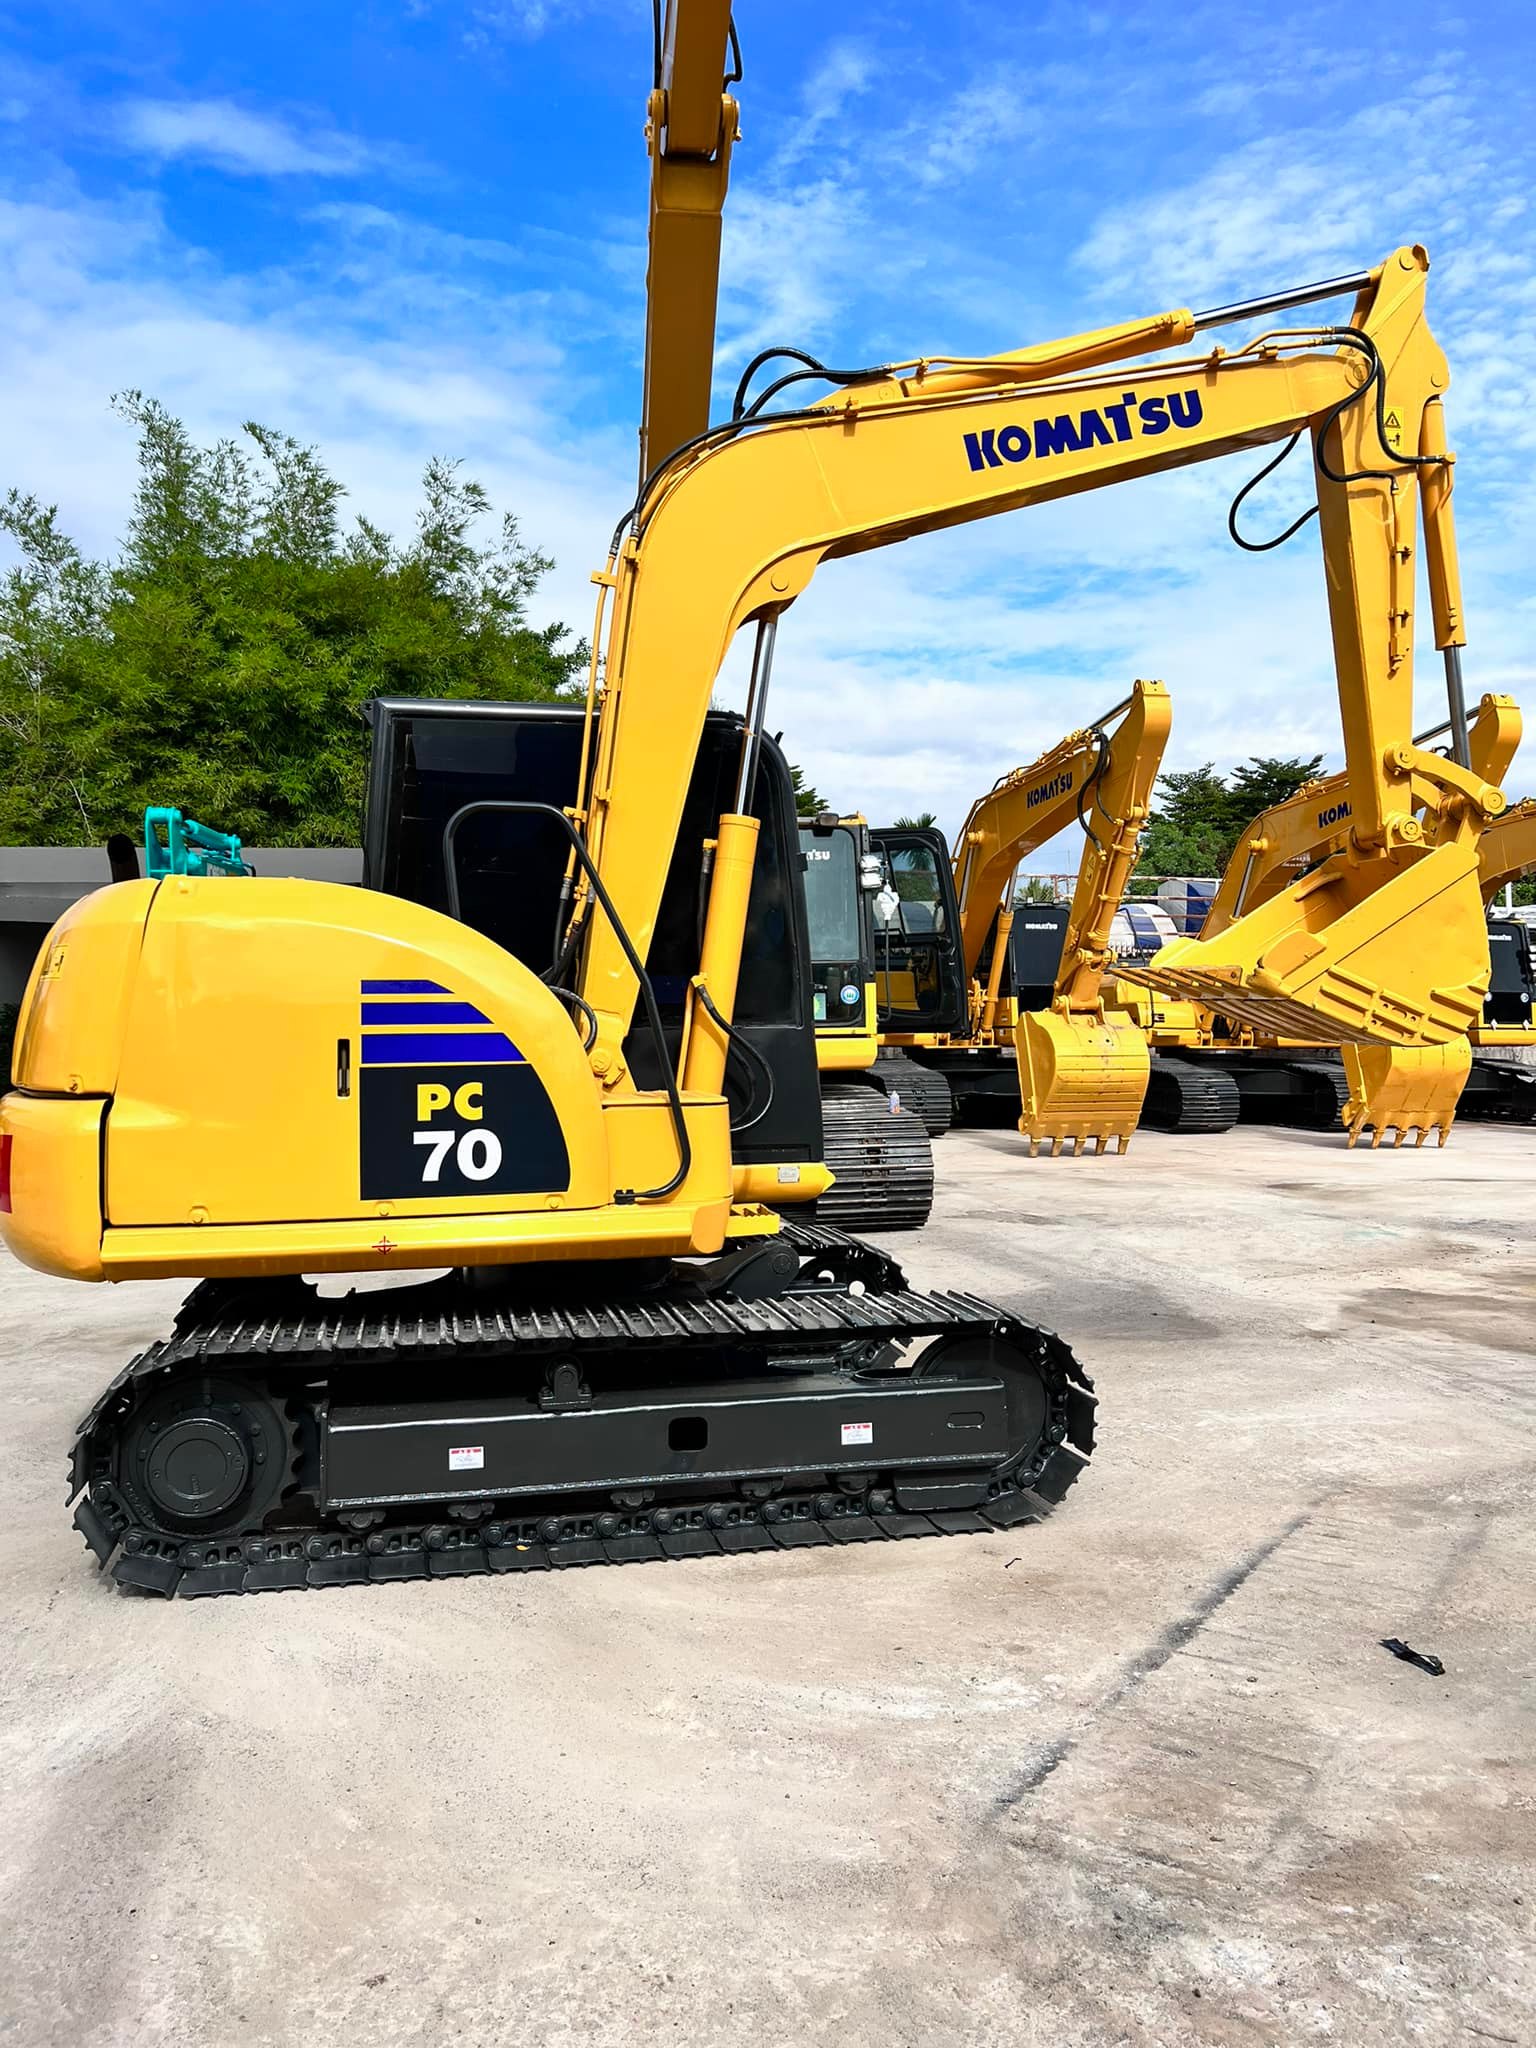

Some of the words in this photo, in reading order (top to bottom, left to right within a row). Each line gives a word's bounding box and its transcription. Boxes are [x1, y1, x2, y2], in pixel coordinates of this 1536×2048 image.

[963, 390, 1203, 472] KOMATSU
[1027, 772, 1073, 809] KOMATSU
[417, 1082, 483, 1122] PC
[413, 1128, 502, 1182] 70
